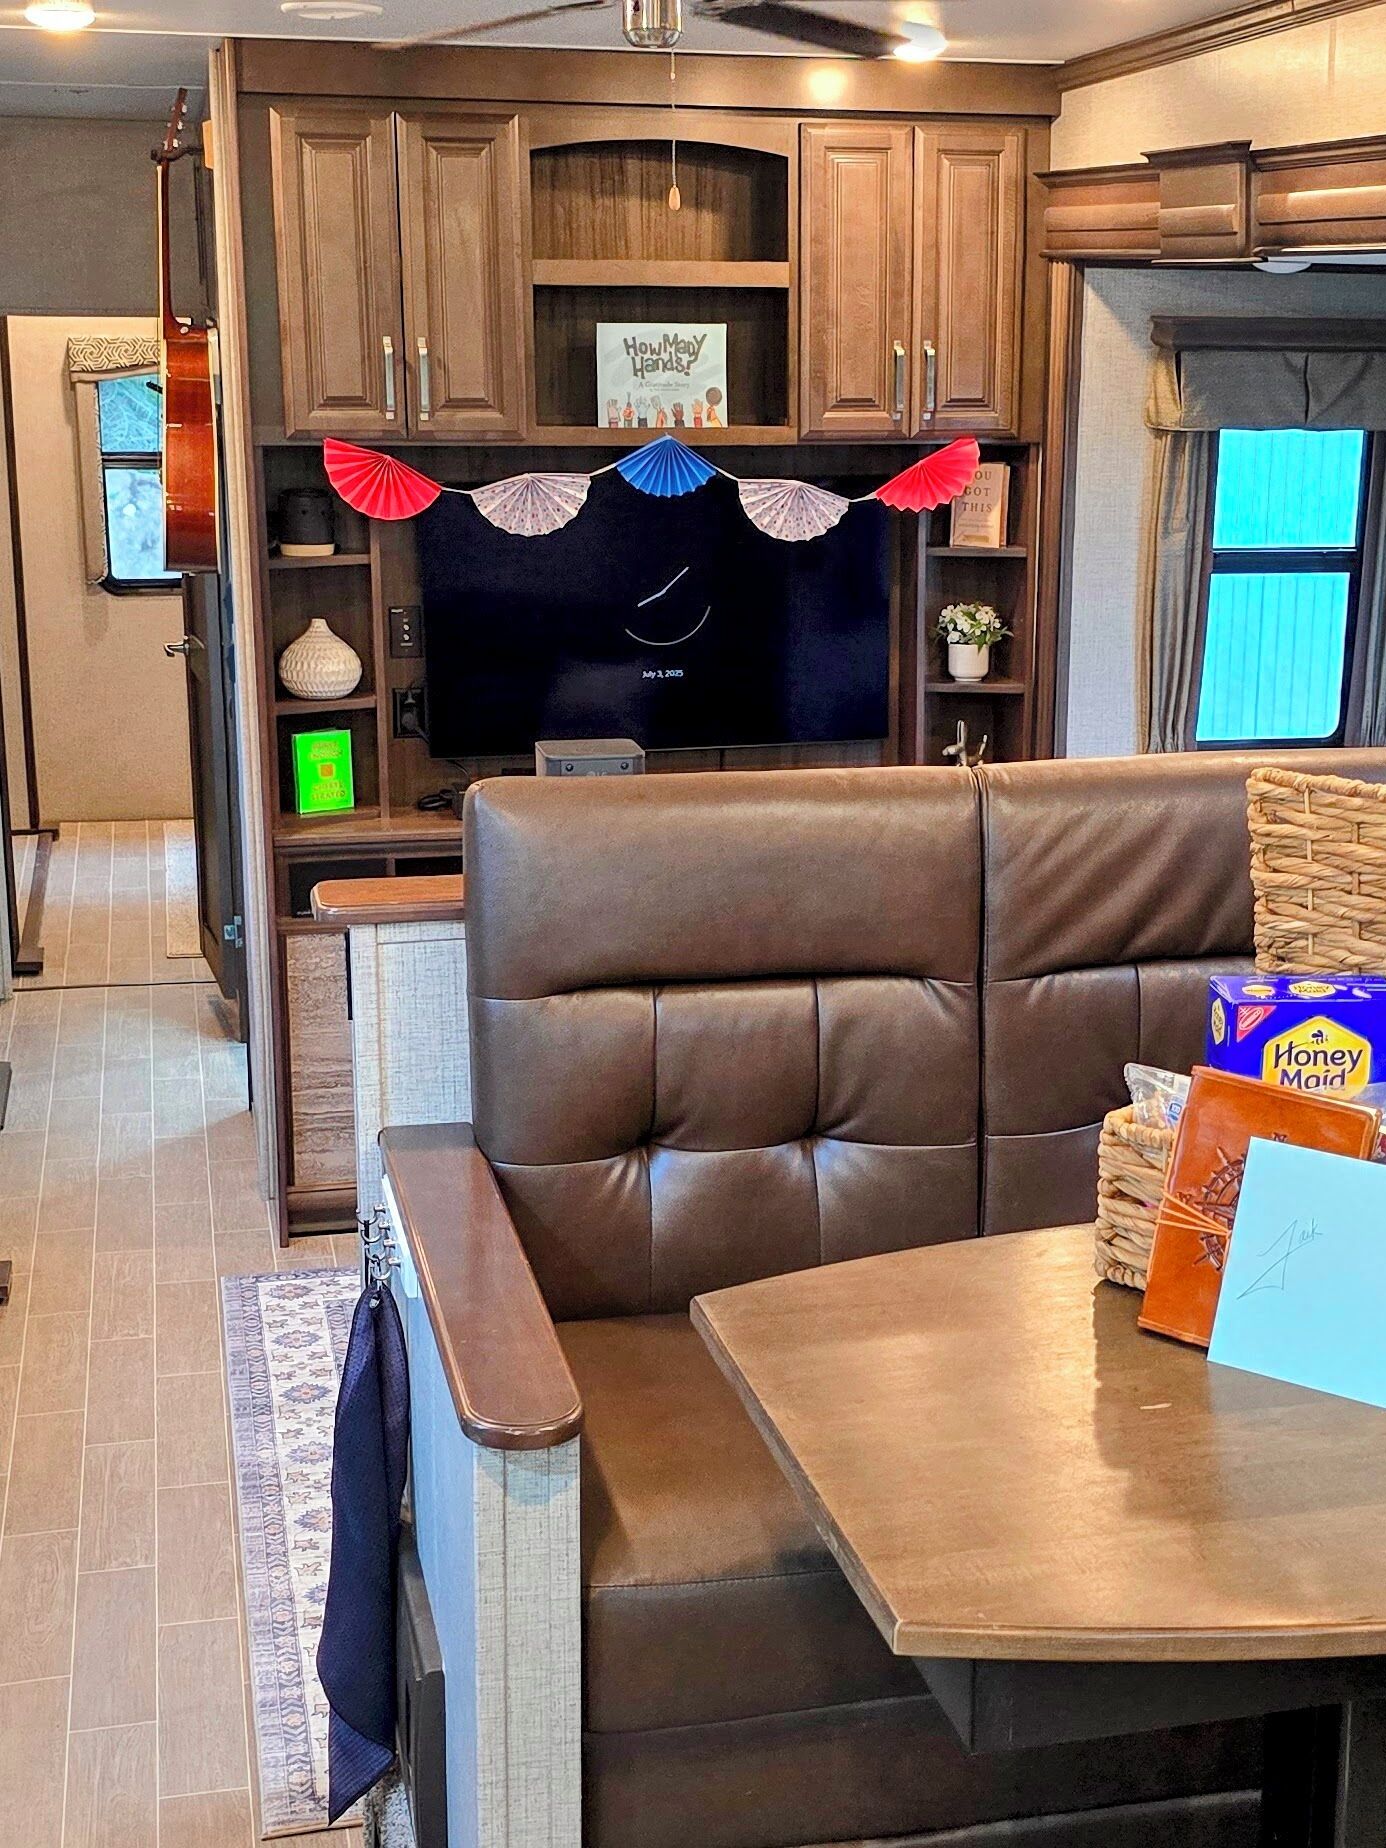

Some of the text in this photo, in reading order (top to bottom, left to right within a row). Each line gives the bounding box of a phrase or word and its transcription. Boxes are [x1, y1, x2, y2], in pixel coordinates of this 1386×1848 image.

[623, 333, 707, 358] How Many
[974, 471, 992, 480] OU
[964, 487, 991, 497] GOT
[961, 502, 993, 512] THIS
[642, 670, 656, 679] July
[665, 669, 684, 677] 2025
[1273, 1041, 1363, 1074] Honey
[1280, 1068, 1347, 1091] Maid
